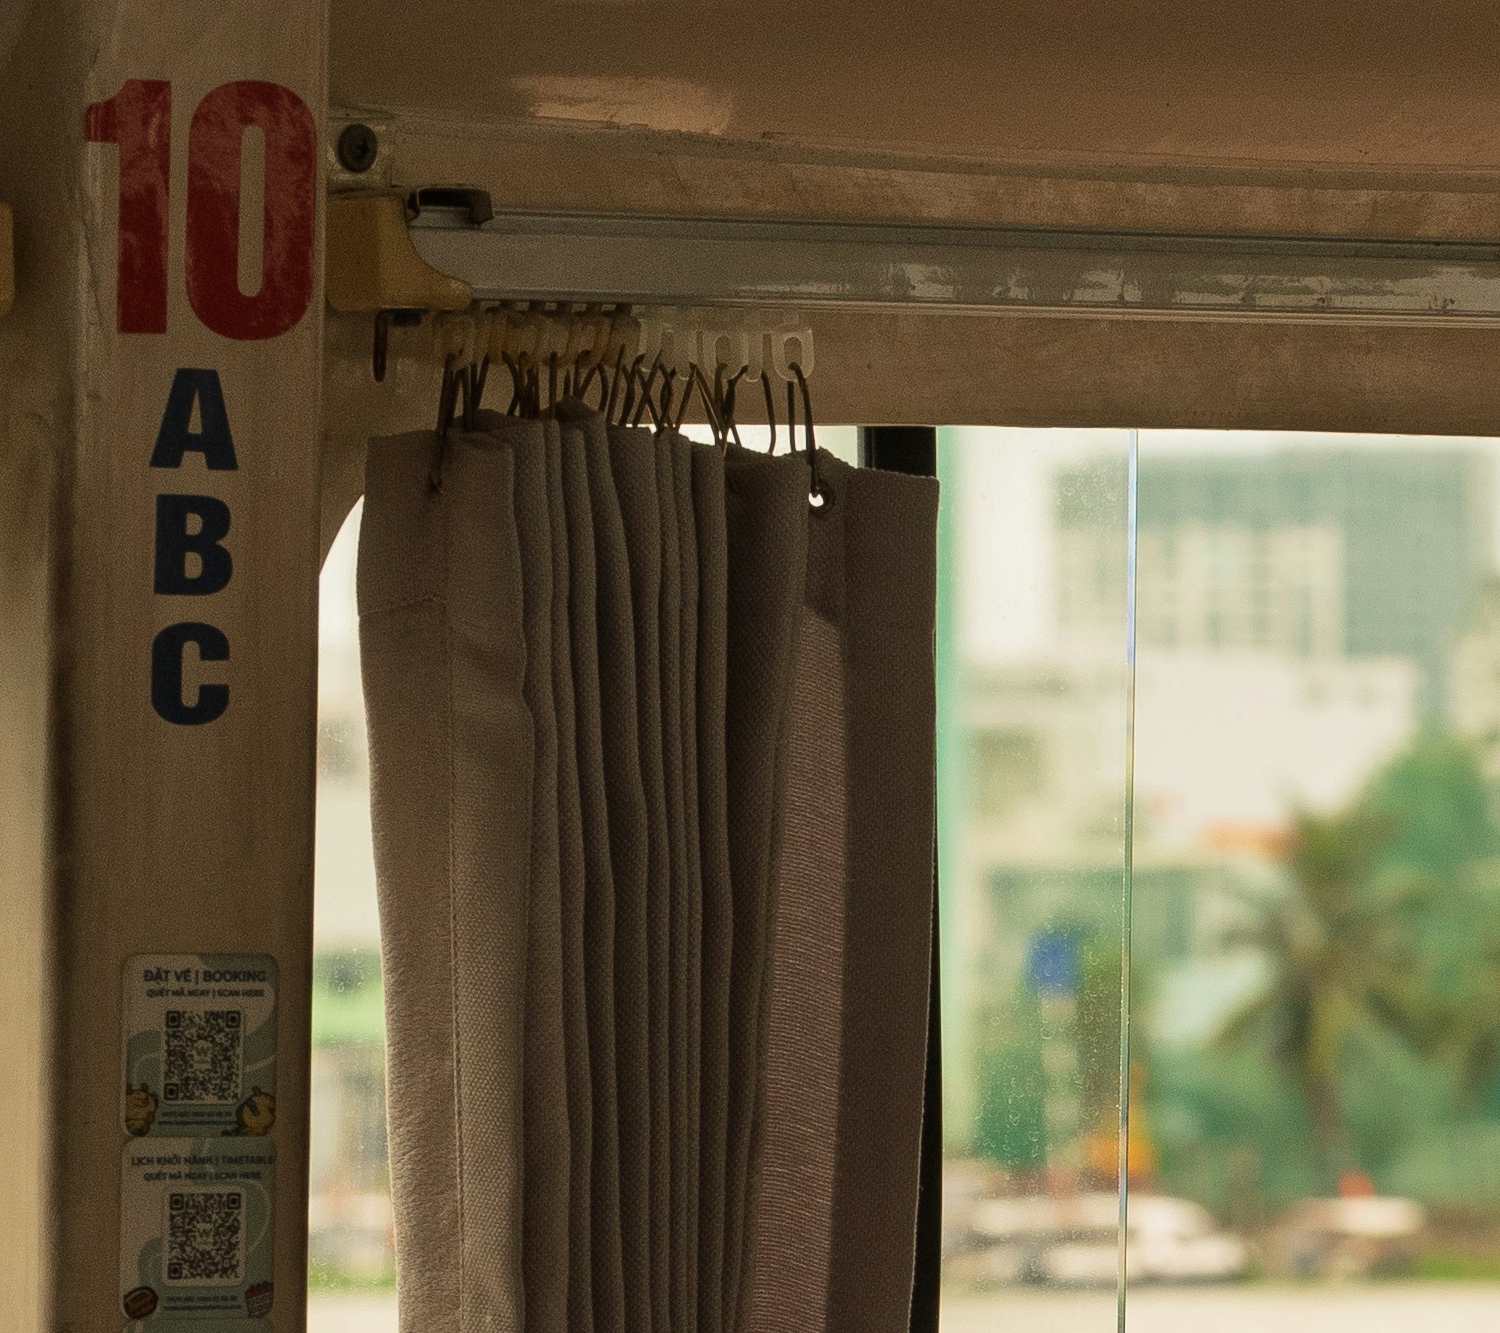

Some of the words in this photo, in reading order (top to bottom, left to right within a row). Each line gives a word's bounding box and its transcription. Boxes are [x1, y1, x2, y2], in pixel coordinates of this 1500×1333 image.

[84, 79, 318, 341] 10
[149, 367, 239, 471] A
[153, 493, 234, 596] B
[150, 621, 231, 726] C
[203, 970, 267, 982] BOOKING
